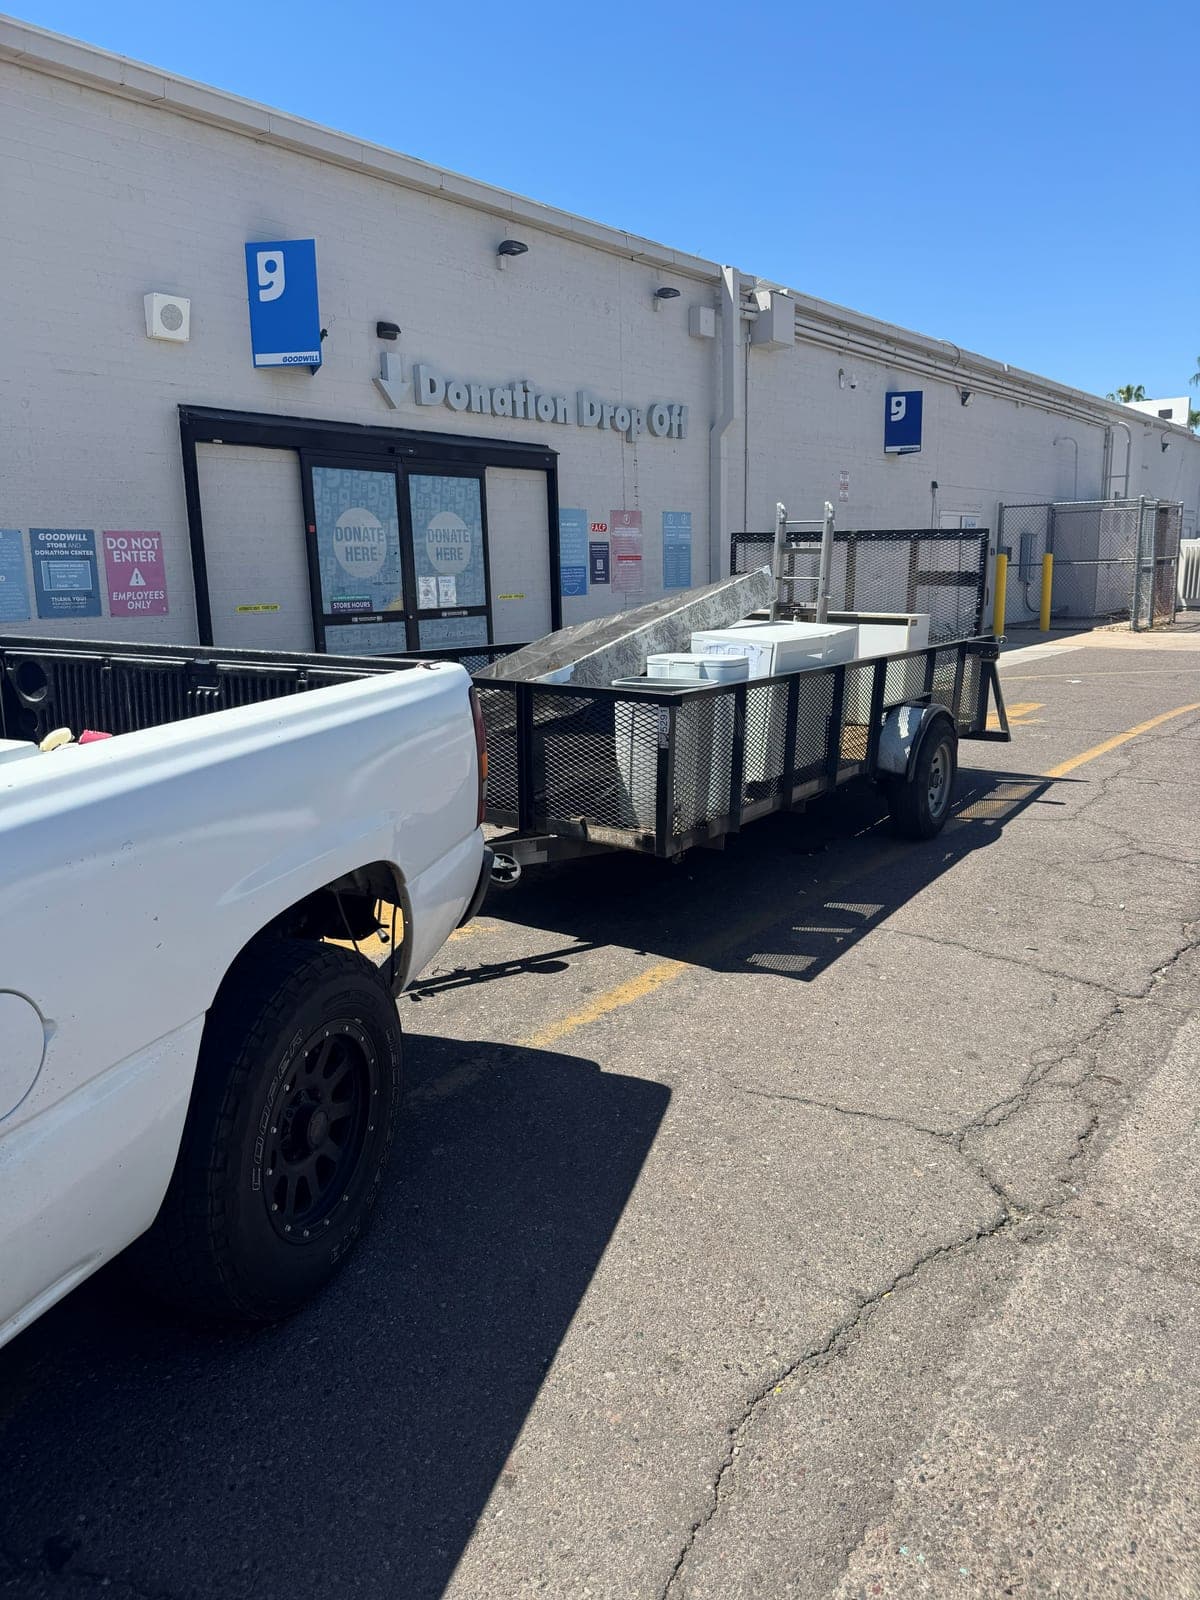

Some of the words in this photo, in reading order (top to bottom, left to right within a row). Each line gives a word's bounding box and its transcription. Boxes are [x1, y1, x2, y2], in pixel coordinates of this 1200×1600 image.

[282, 355, 319, 363] GOODWILL
[412, 364, 575, 425] Donation
[577, 391, 642, 443] Drop
[648, 401, 689, 440] Off
[38, 533, 88, 541] GOODWILL
[335, 526, 385, 543] DONATE
[427, 528, 470, 544] DONATE
[106, 537, 129, 550] DO
[131, 538, 160, 550] NOT
[113, 551, 157, 562] ENTER
[345, 546, 378, 562] HERE
[435, 547, 464, 561] HERE
[112, 590, 165, 601] EMPLOYEES
[127, 600, 152, 610] ONLY
